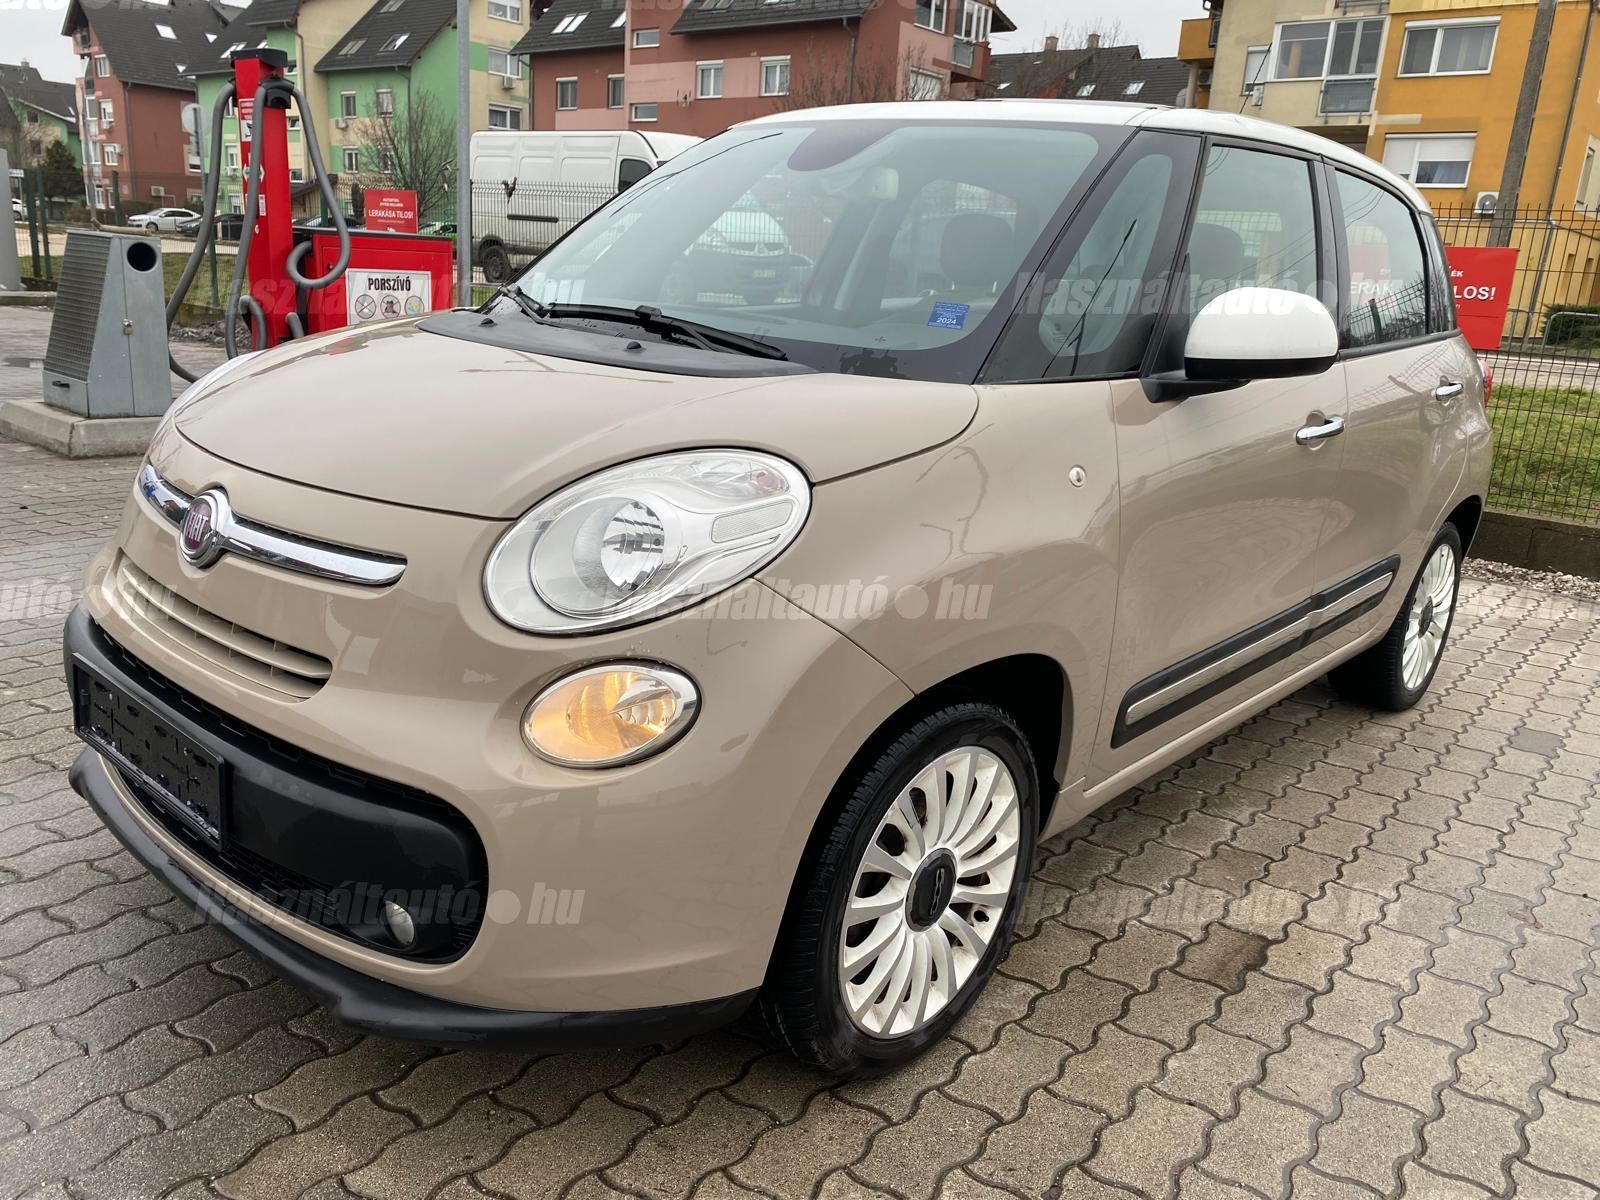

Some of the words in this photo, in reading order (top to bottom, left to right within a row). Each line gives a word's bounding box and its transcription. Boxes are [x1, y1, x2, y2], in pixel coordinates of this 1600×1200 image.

[369, 208, 396, 218] LERAKÁSA
[1451, 269, 1464, 278] ÉK
[368, 275, 411, 291] PORSZÍVÓ
[1453, 285, 1496, 300] LOS!
[936, 317, 957, 325] 2024
[184, 511, 208, 542] FIAT
